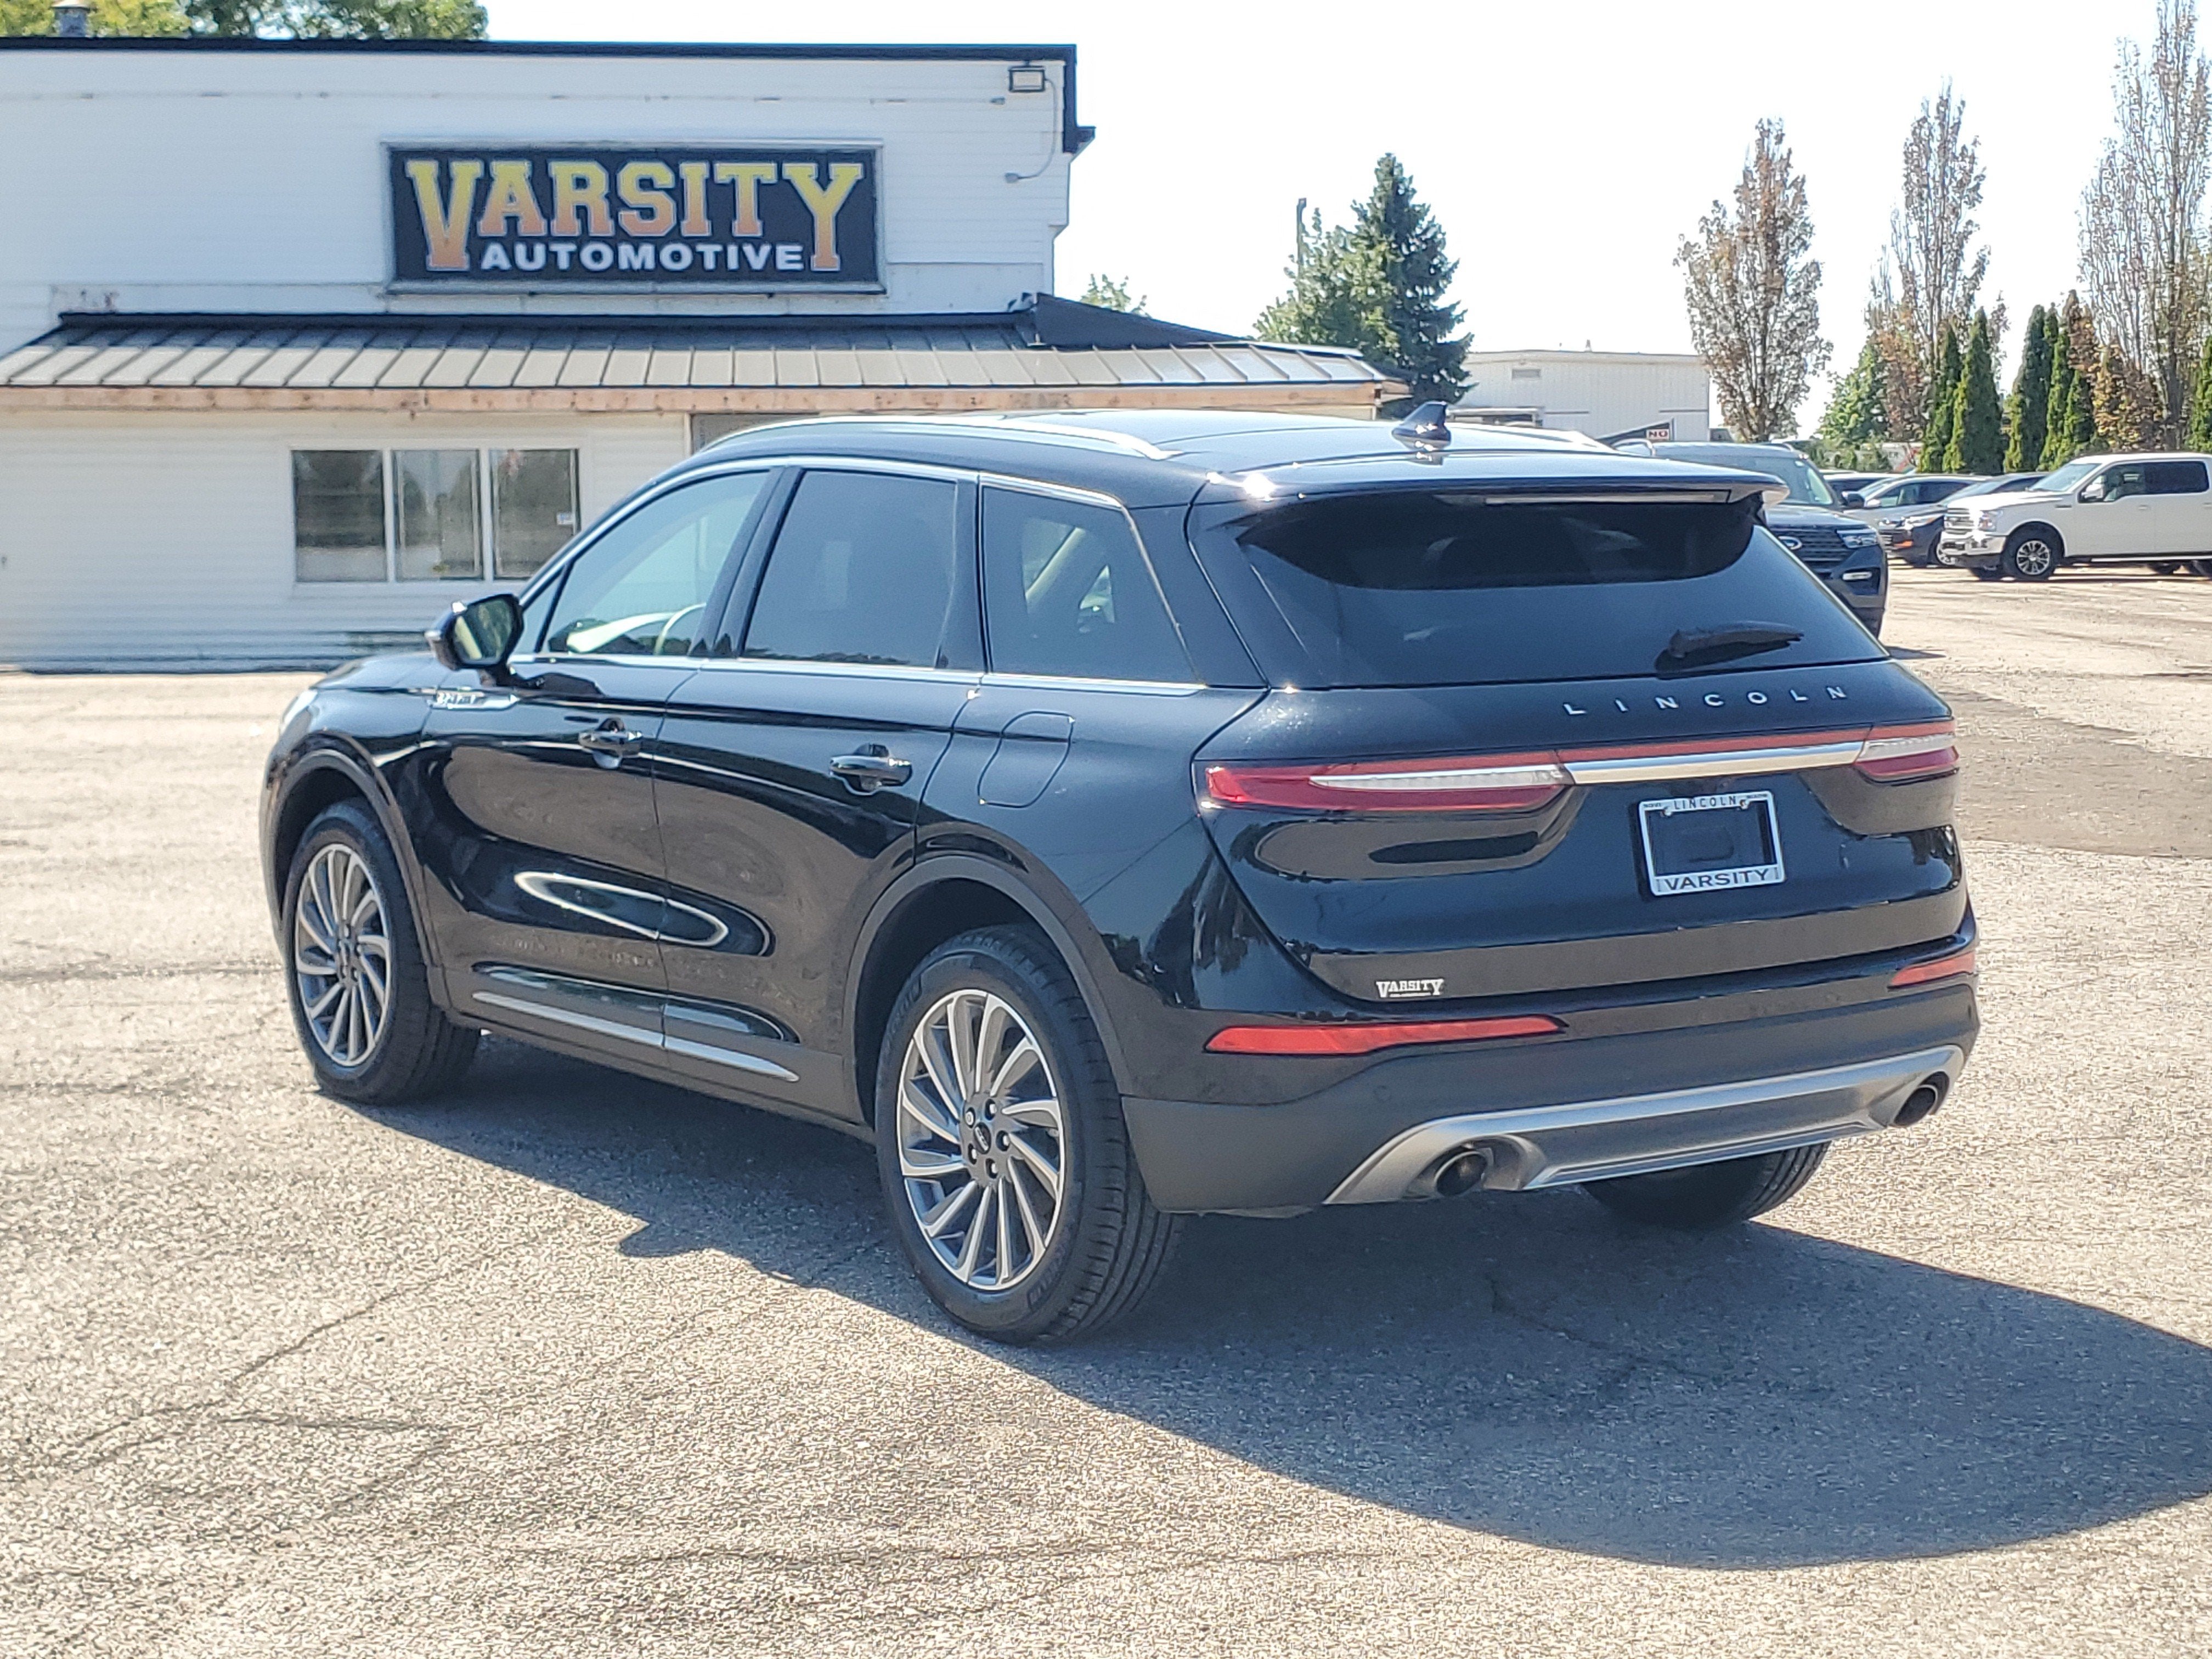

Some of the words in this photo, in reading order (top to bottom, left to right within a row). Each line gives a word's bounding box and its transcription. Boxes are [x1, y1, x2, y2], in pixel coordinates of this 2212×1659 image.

[405, 160, 864, 272] VARSITY
[480, 242, 804, 271] AUTOMOTIVE
[1564, 686, 1847, 715] LINCOLN
[1674, 795, 1736, 810] LINCOLN
[1664, 868, 1770, 891] VARSITY
[1376, 978, 1444, 998] VARSITY
